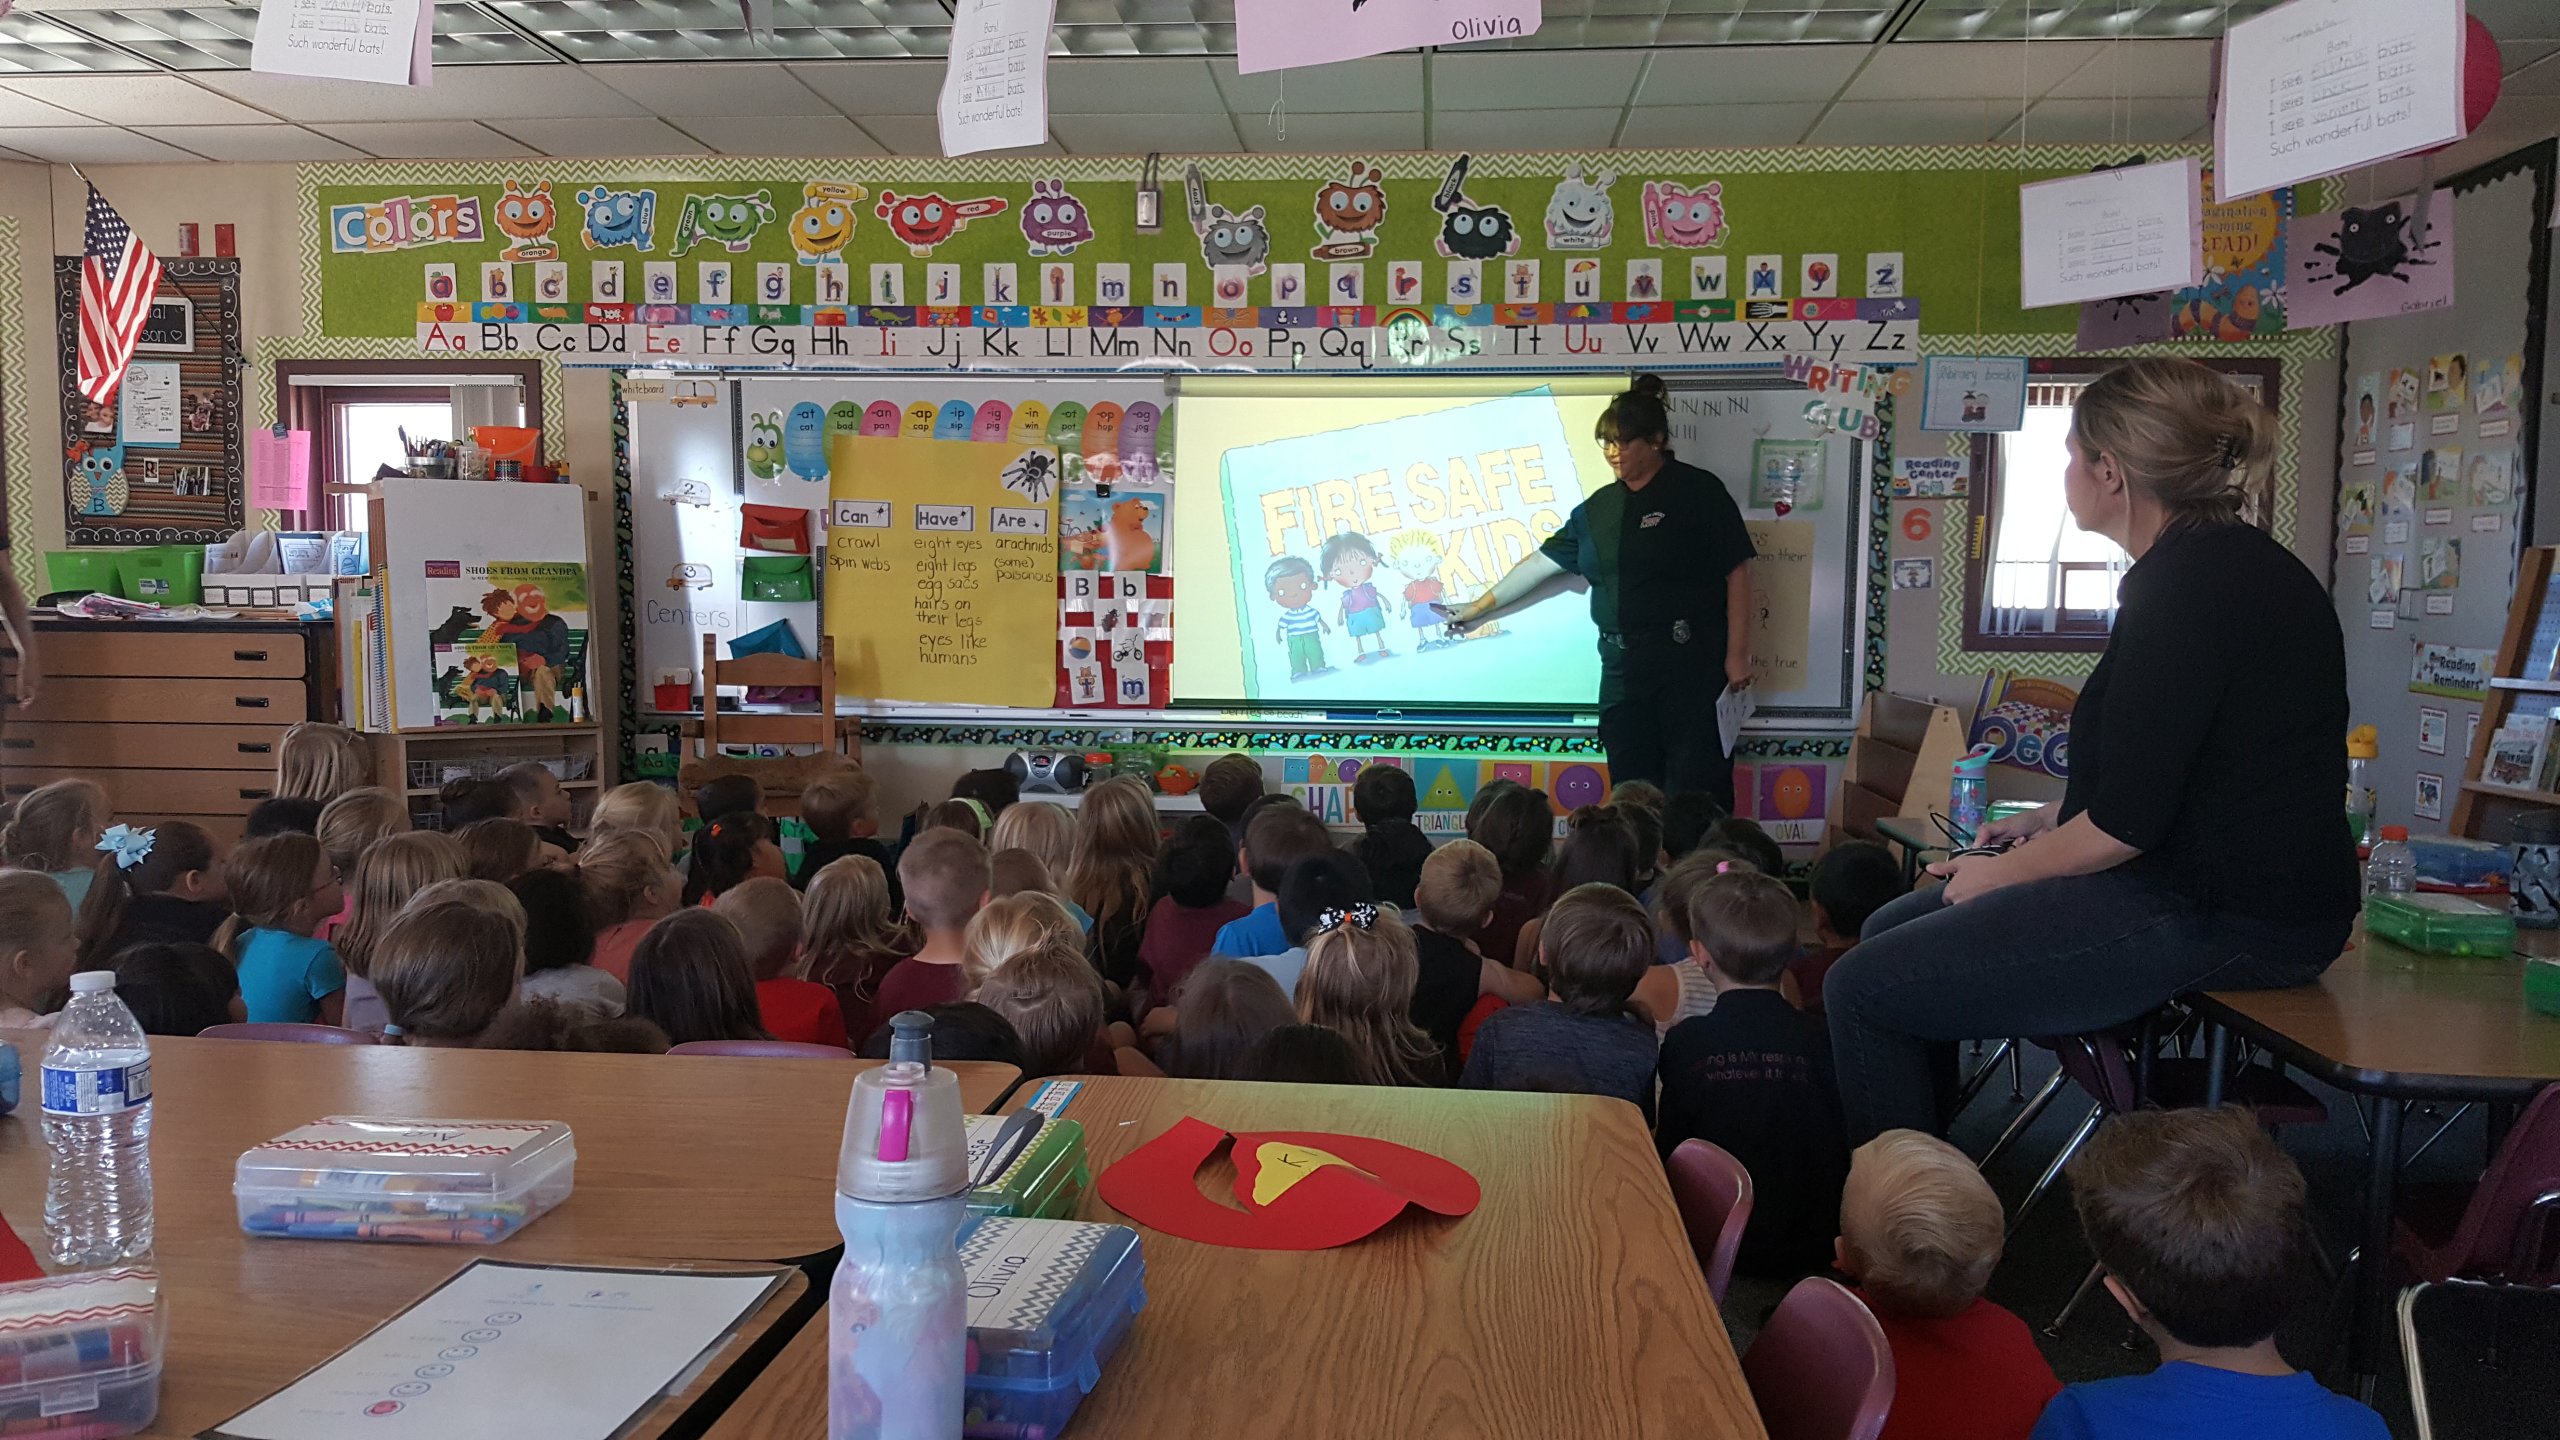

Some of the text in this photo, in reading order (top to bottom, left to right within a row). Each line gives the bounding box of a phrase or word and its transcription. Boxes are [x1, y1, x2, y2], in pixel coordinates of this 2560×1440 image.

[1452, 15, 1522, 40] Olivia
[288, 34, 383, 55] Such wonderful bats!
[971, 104, 1005, 123] wonderful
[1006, 99, 1023, 119] bats!
[2270, 136, 2301, 156] Such
[2306, 114, 2373, 146] wonderful
[2377, 102, 2412, 126] bats!
[822, 185, 846, 195] yellow
[967, 204, 980, 212] red
[641, 207, 649, 225] blue
[684, 209, 694, 232] green
[339, 203, 476, 246] Colors
[1046, 229, 1072, 239] purple
[1563, 235, 1586, 244] white
[521, 249, 547, 257] orange
[1334, 246, 1359, 254] brown
[2086, 262, 2134, 280] wonderful
[433, 279, 453, 298] a
[491, 275, 508, 297] b
[543, 279, 559, 297] c
[601, 273, 617, 297] d
[654, 276, 669, 292] e
[707, 271, 725, 297] f
[766, 277, 783, 299] g
[995, 275, 1010, 301] k
[1103, 280, 1125, 296] m
[1163, 279, 1178, 297] n
[1224, 284, 1238, 298] o
[1281, 278, 1297, 299] p
[1459, 279, 1471, 295] s
[1575, 281, 1590, 297] u
[1636, 276, 1652, 293] v
[1698, 274, 1721, 291] w
[1811, 273, 1825, 291] y
[1877, 267, 1895, 285] z
[425, 323, 466, 351] Aa
[482, 323, 518, 351] Bb
[537, 324, 576, 351] Cc
[588, 324, 625, 352] Dd
[646, 325, 681, 353] Ee
[704, 325, 740, 354] Ff
[751, 325, 795, 367] Gg
[811, 327, 848, 356] Hh
[880, 327, 896, 356] Ii
[927, 328, 960, 368] Jj
[984, 327, 1018, 356] Kk
[1046, 328, 1072, 356] Ll
[1091, 328, 1139, 356] Mm
[1154, 328, 1191, 356] Nn
[1209, 327, 1253, 356] Oo
[1269, 328, 1305, 369] Pp
[1320, 327, 1373, 369] Qq
[1446, 327, 1481, 355] Ss
[1505, 325, 1541, 355] Tt
[1565, 324, 1602, 354] Uu
[1627, 324, 1659, 352] Vv
[1678, 323, 1731, 352] Ww
[1745, 322, 1786, 351] Xx
[1804, 321, 1845, 361] Yy
[1868, 320, 1905, 350] Zz
[1783, 354, 1911, 401] WRITING
[621, 383, 664, 396] whiteboard
[800, 423, 814, 431] cat
[837, 422, 853, 430] bad
[874, 422, 890, 431] pan
[913, 423, 929, 432] cap
[950, 421, 963, 430] sip
[987, 422, 1000, 431] pig
[1025, 421, 1039, 430] win
[1061, 423, 1076, 431] pot
[1097, 422, 1114, 431] hop
[1134, 422, 1149, 433] jog
[1906, 459, 1960, 471] Reading
[1909, 469, 1958, 480] Center
[684, 483, 696, 495] 2
[93, 498, 105, 512] B
[1259, 444, 1557, 556] FIRE SAFE
[841, 509, 869, 525] Can
[919, 511, 958, 526] Have
[998, 513, 1026, 528] Are
[1903, 507, 1932, 541] 6
[837, 534, 880, 549] crawl
[914, 536, 983, 559] eight eyes
[995, 537, 1054, 553] arachnids
[1437, 509, 1562, 597] KIDS
[829, 555, 891, 572] spin webs
[916, 559, 977, 579] eight legs
[994, 556, 1034, 569] (some)
[427, 566, 459, 577] Reading
[466, 566, 578, 576] SHOES FROM GRANDPA
[684, 565, 696, 578] 3
[996, 570, 1054, 583] poisonous
[918, 578, 979, 601] egg sacs
[1075, 577, 1137, 597] B b
[915, 596, 971, 610] hairs on
[647, 600, 731, 627] Centers
[916, 611, 983, 634] their legs
[919, 633, 988, 652] eyes like
[919, 647, 978, 665] humans
[1775, 654, 1798, 668] true
[2439, 656, 2476, 674] Reading
[1123, 680, 1145, 695] m
[2433, 672, 2480, 690] Reminders
[968, 1255, 1030, 1299] Olivia
